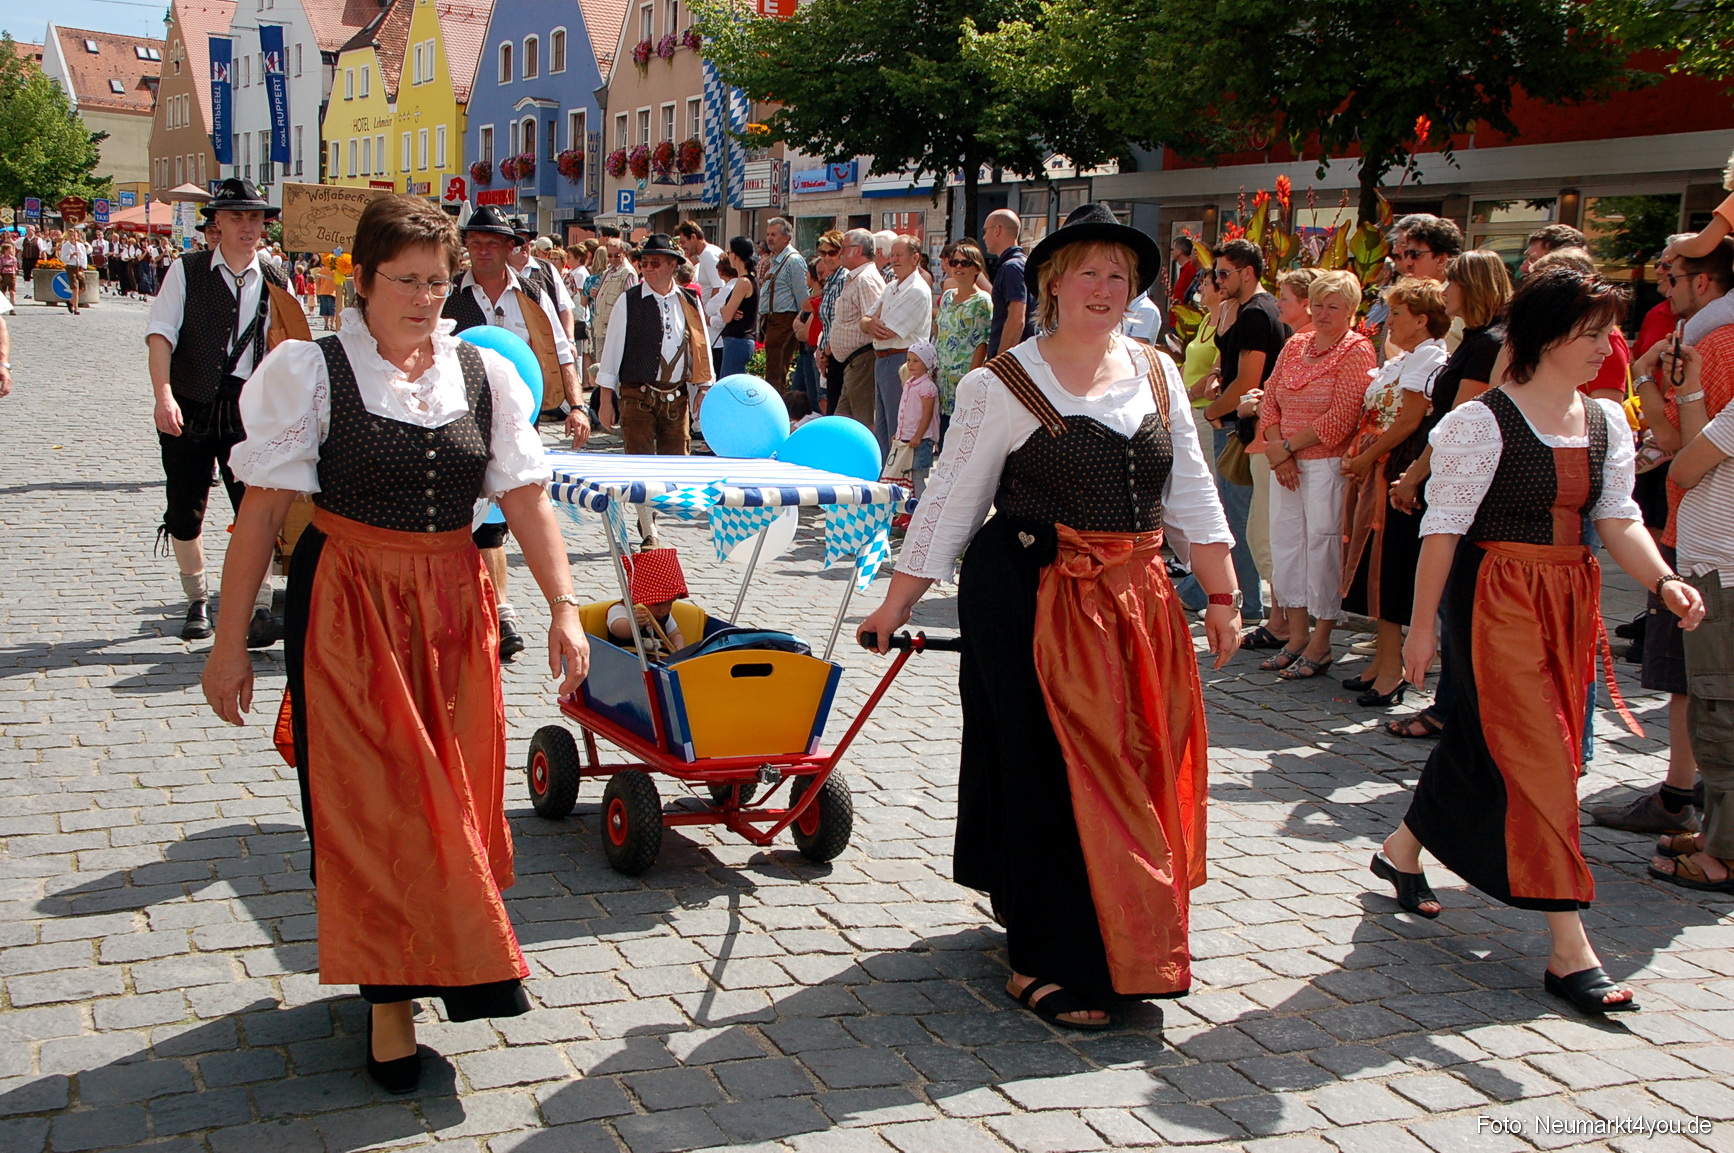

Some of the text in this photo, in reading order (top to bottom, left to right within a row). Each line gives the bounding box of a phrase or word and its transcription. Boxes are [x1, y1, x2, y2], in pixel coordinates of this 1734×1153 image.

[273, 77, 284, 126] RUPPERT
[353, 116, 370, 133] HOTEL
[621, 192, 631, 211] P
